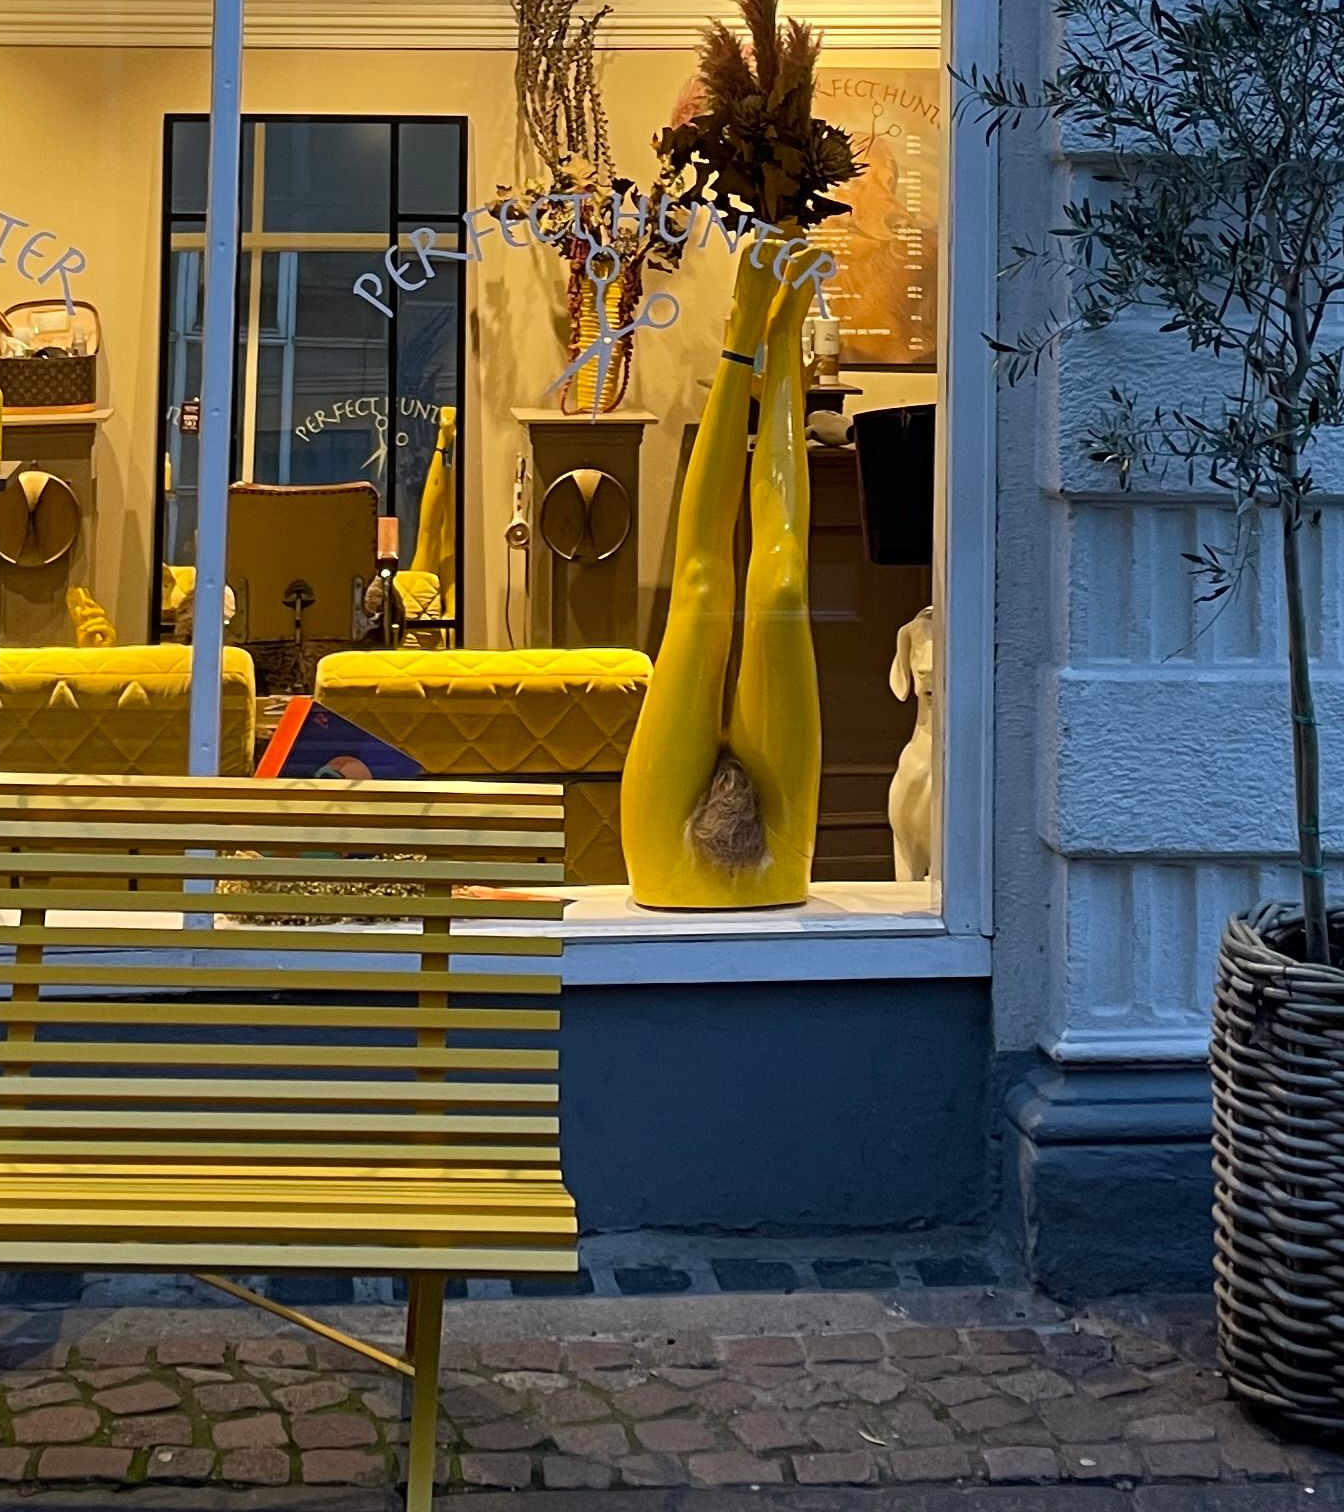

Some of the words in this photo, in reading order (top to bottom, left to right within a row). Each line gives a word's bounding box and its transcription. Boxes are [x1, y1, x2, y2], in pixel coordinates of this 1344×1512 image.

[352, 192, 596, 319] PERFECT
[612, 191, 838, 320] HUNTER
[295, 396, 380, 443] PERFECT
